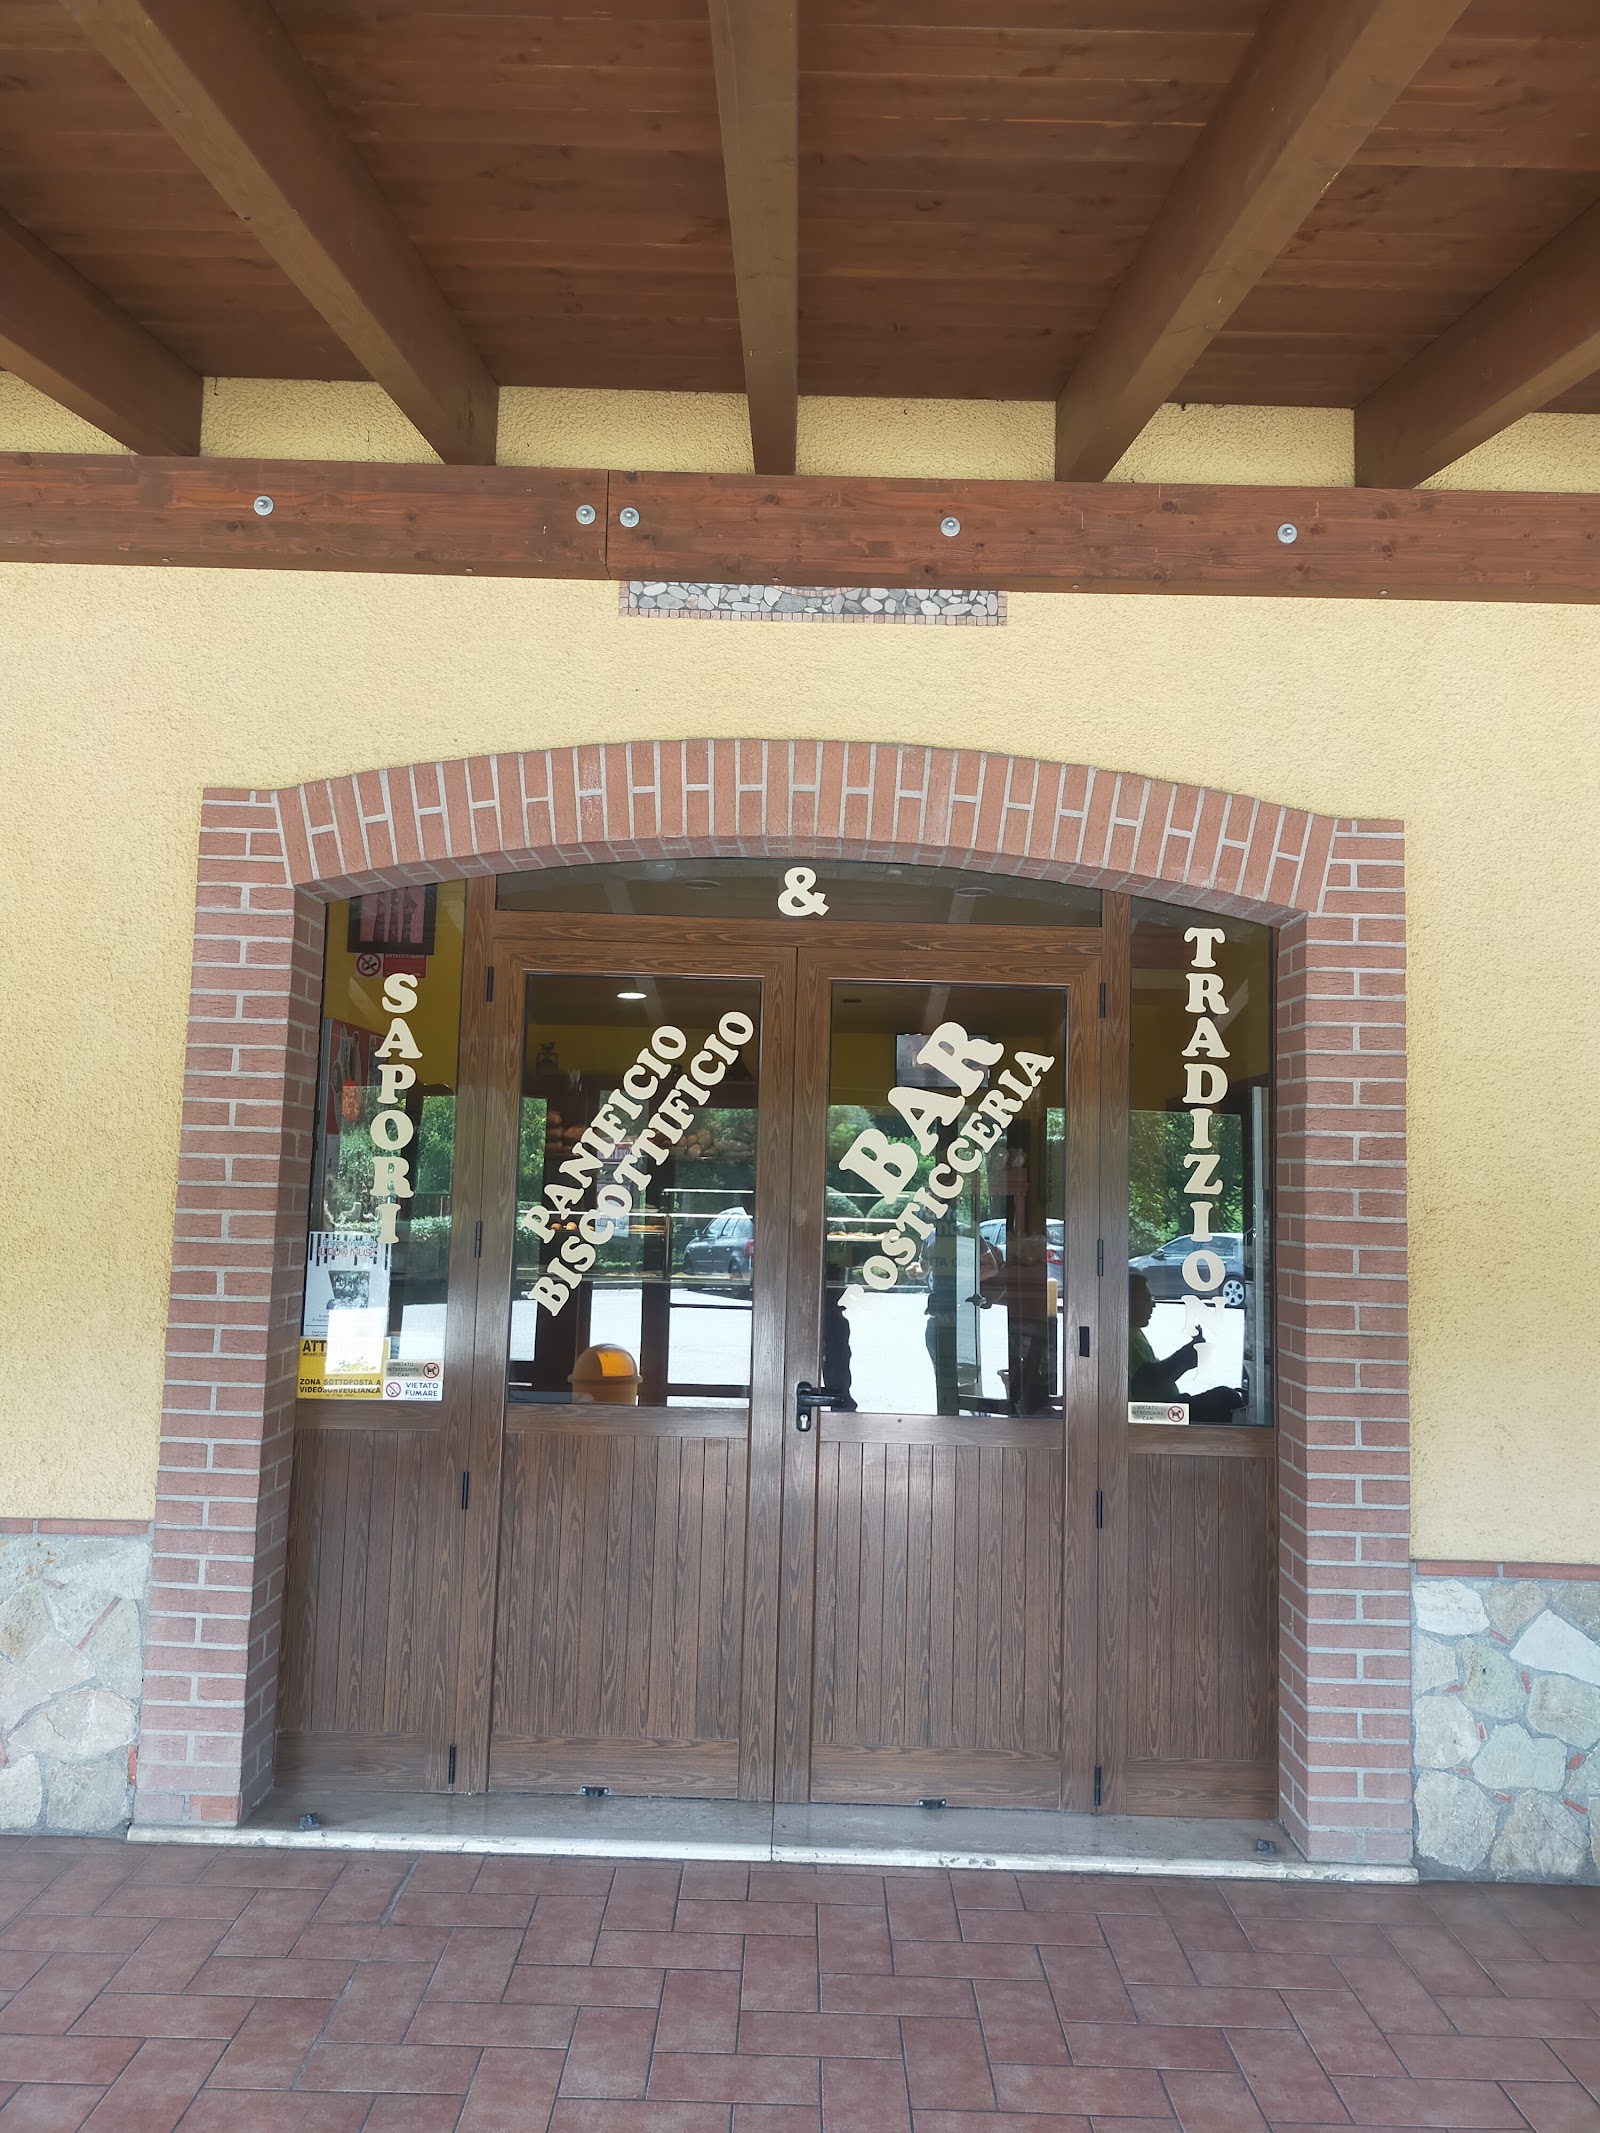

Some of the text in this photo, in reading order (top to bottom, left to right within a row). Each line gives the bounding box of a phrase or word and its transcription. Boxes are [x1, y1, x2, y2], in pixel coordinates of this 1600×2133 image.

[777, 867, 829, 917] &
[370, 973, 423, 1245] SAPORI
[521, 1025, 687, 1244] PANIFICIO
[528, 1011, 754, 1317] BISCOTTIFICIO
[839, 1021, 1004, 1205] BAR
